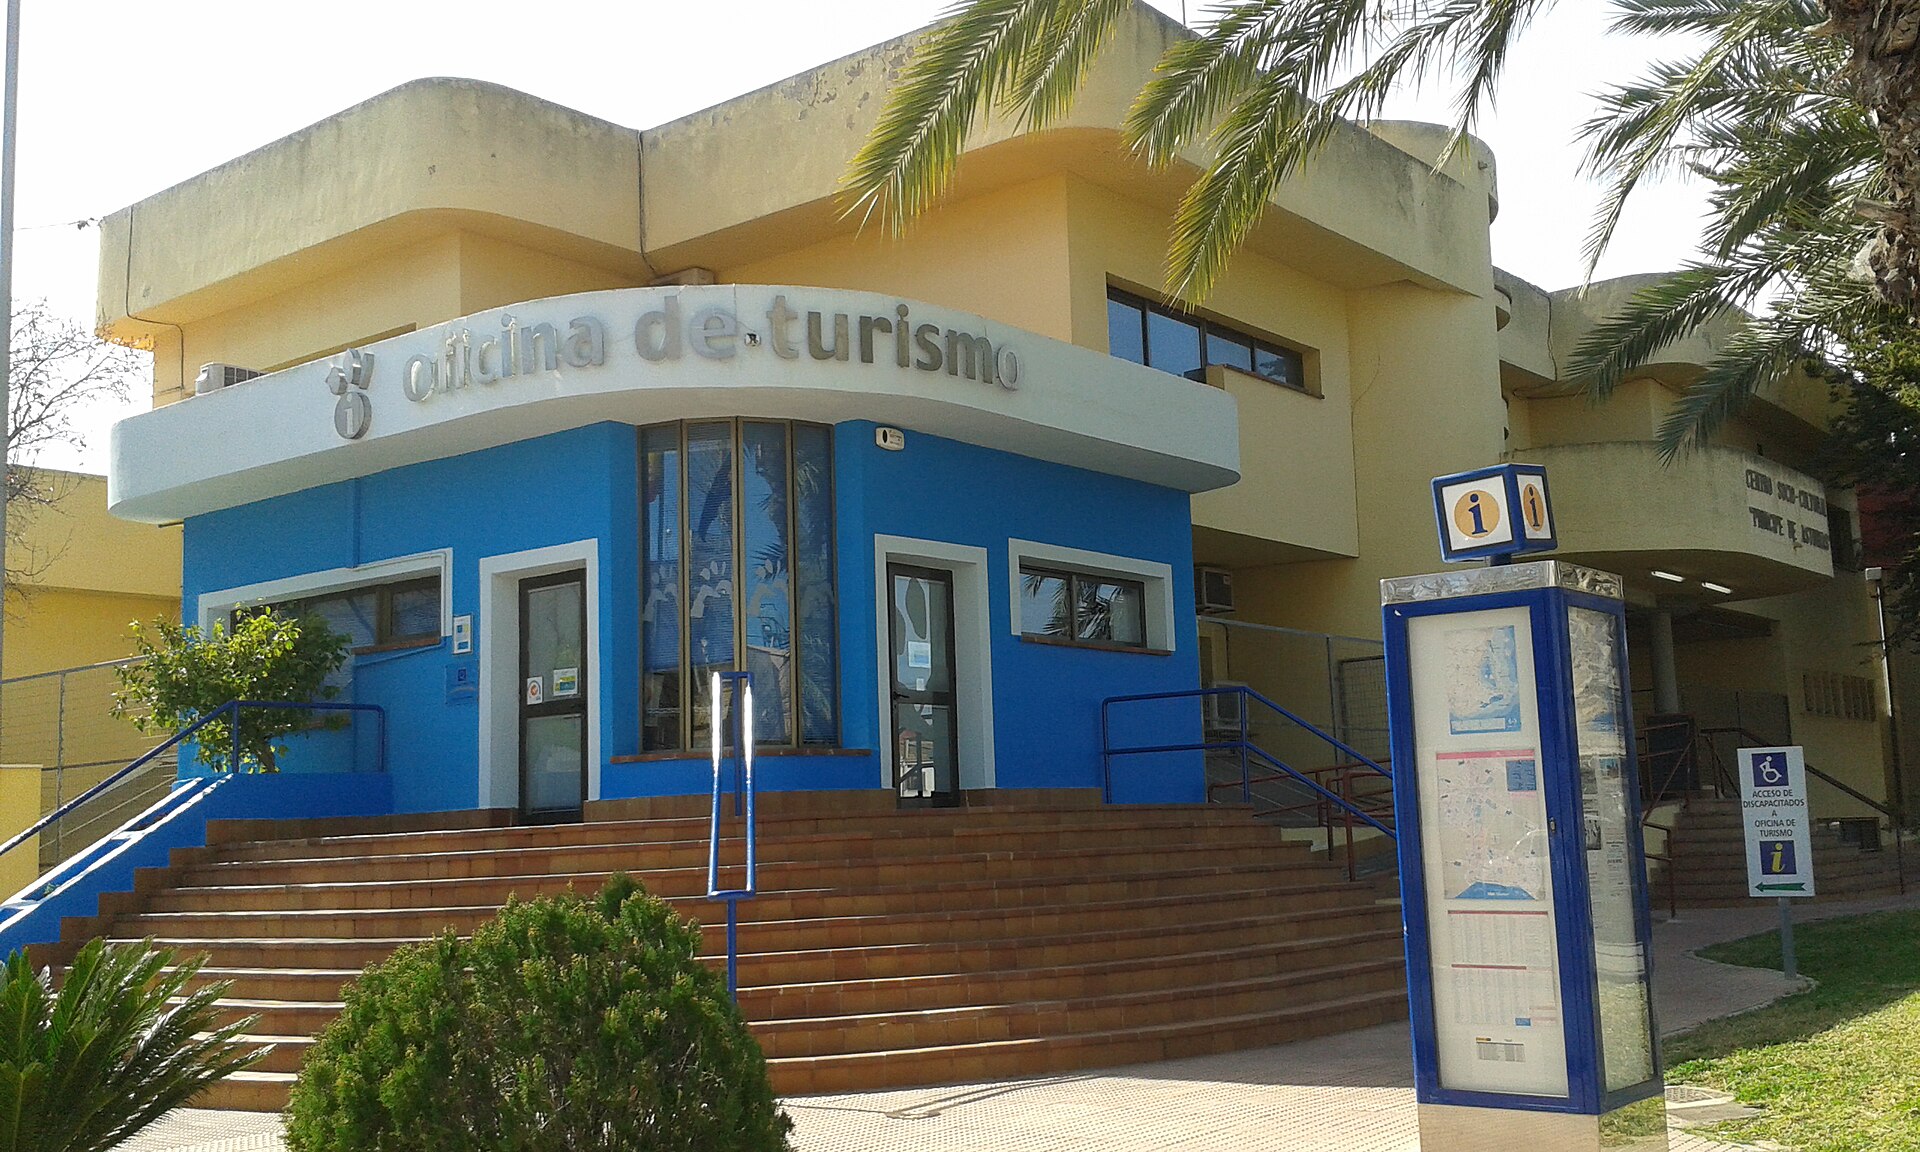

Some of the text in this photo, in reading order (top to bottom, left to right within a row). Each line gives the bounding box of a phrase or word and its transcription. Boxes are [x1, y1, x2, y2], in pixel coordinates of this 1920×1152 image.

[402, 295, 1021, 403] oficina de turismo
[1752, 789, 1794, 798] ACCESO DE
[1743, 799, 1805, 808] DISCAPACITADOS
[1771, 809, 1778, 817] A
[1754, 818, 1797, 828] OFICINA DE
[1759, 829, 1793, 838] TURISMO
